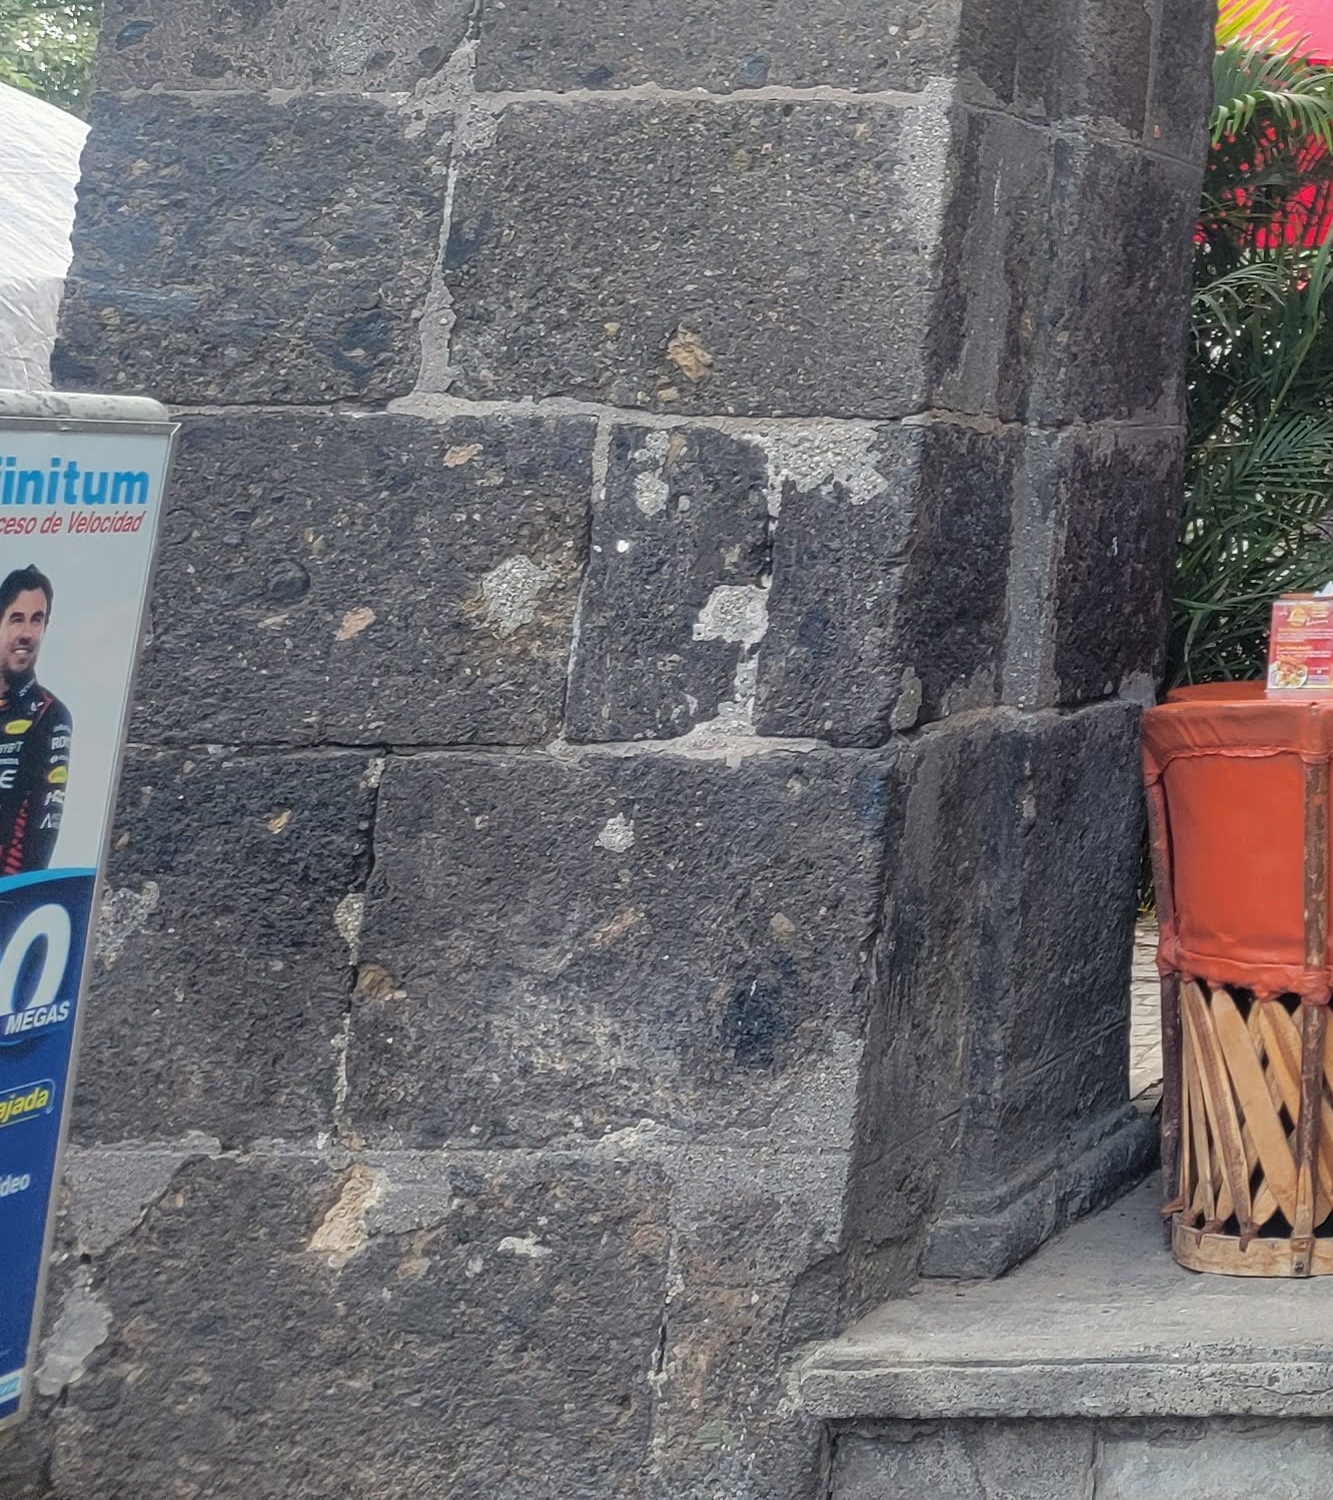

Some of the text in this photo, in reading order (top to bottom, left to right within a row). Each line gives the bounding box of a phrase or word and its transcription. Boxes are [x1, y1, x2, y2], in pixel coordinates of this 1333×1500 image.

[0, 456, 149, 505] initum
[40, 511, 63, 534] de
[67, 510, 146, 534] Velocidad
[4, 1000, 71, 1035] MEGAS
[0, 1173, 31, 1197] deo
